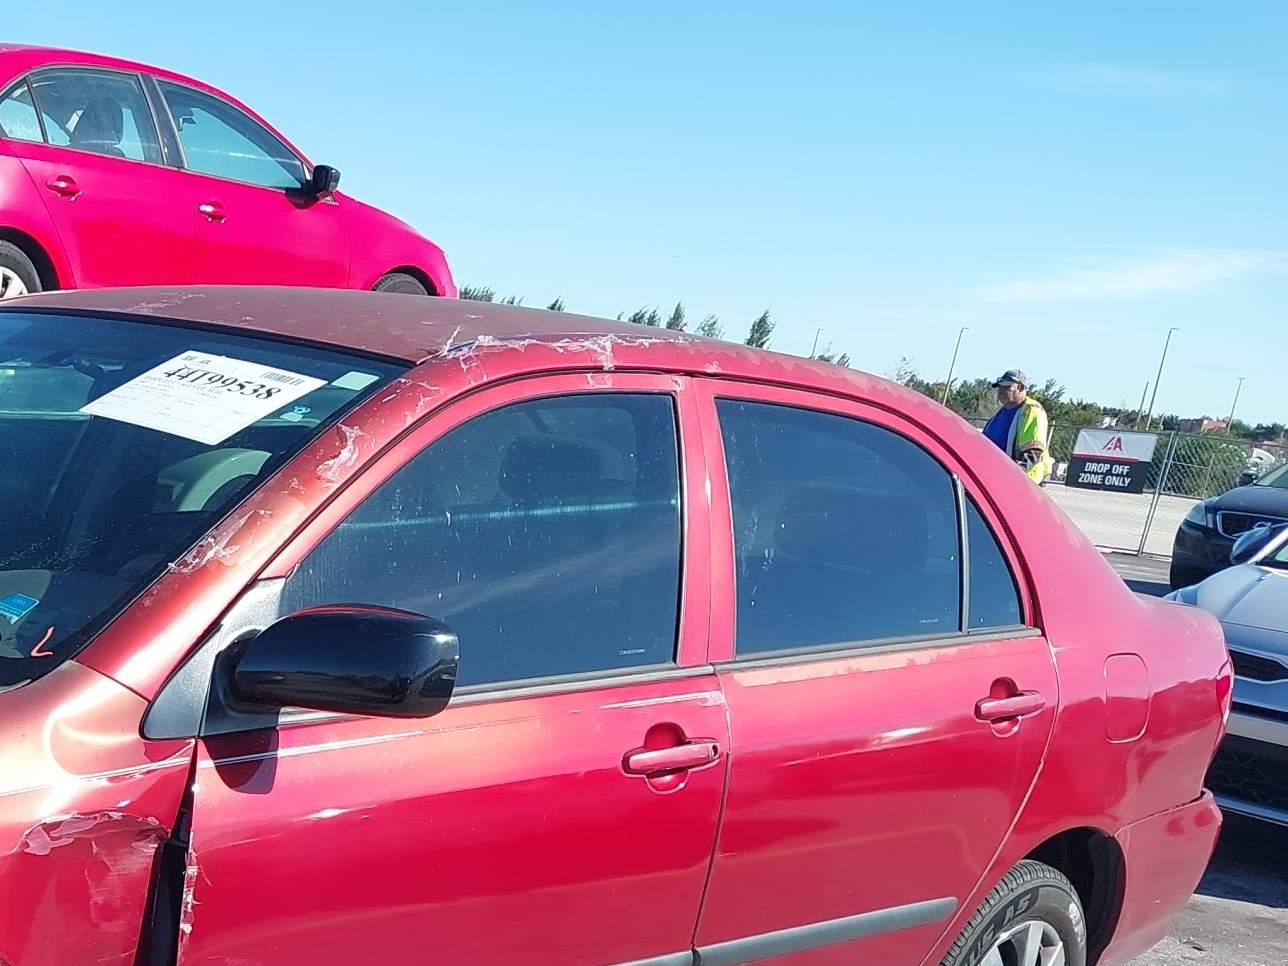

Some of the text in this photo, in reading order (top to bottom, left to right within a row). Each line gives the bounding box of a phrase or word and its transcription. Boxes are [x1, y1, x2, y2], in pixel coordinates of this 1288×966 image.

[163, 364, 282, 401] 44199538
[1084, 461, 1131, 475] DROP OFF
[1077, 473, 1131, 487] ZONE ONLY
